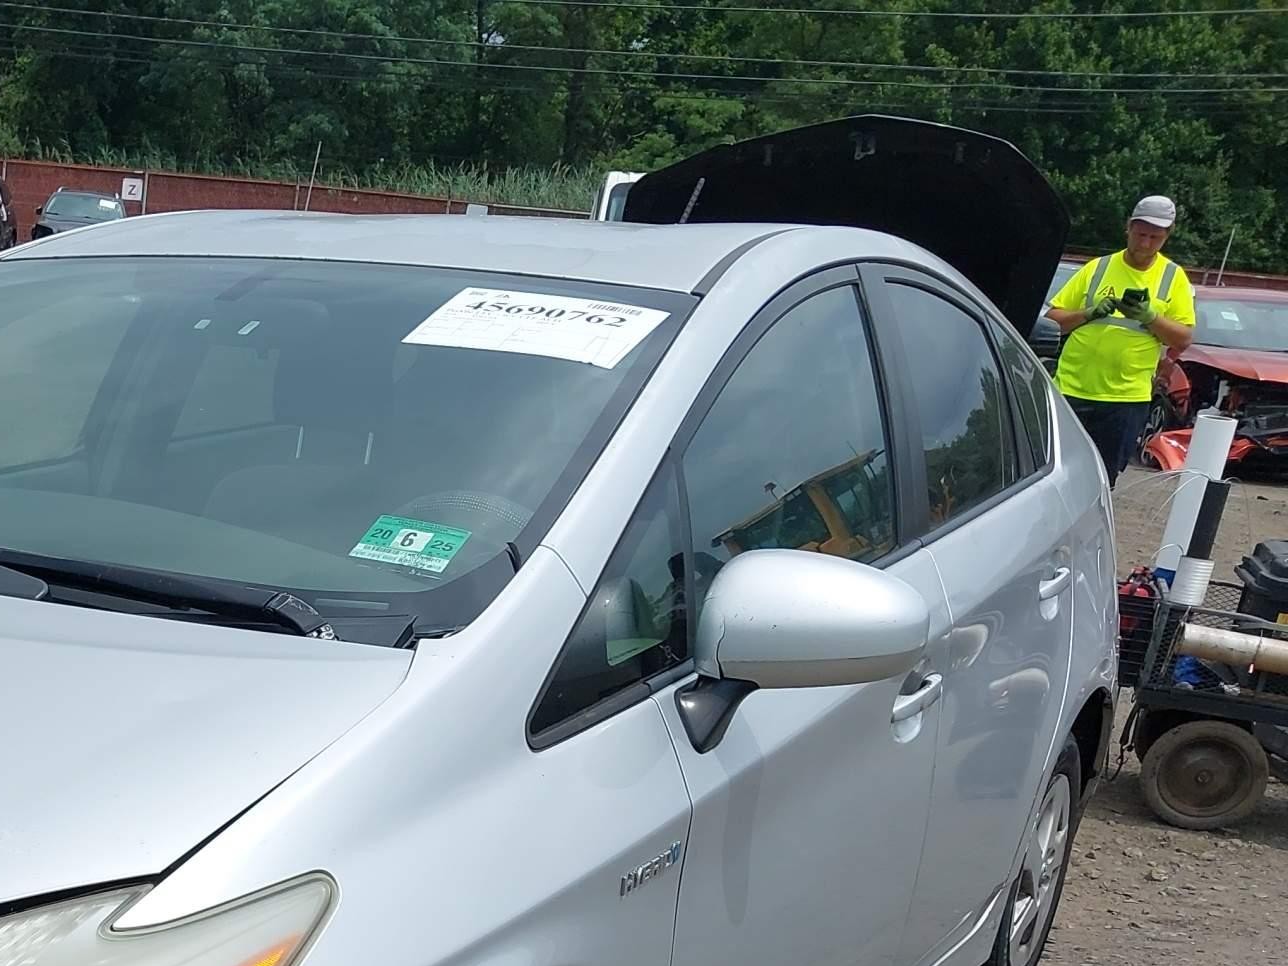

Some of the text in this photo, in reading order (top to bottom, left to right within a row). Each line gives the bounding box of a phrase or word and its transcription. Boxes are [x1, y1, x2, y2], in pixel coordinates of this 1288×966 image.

[127, 184, 137, 196] Z
[465, 299, 629, 328] 45690762
[370, 527, 454, 553] 20 6 25
